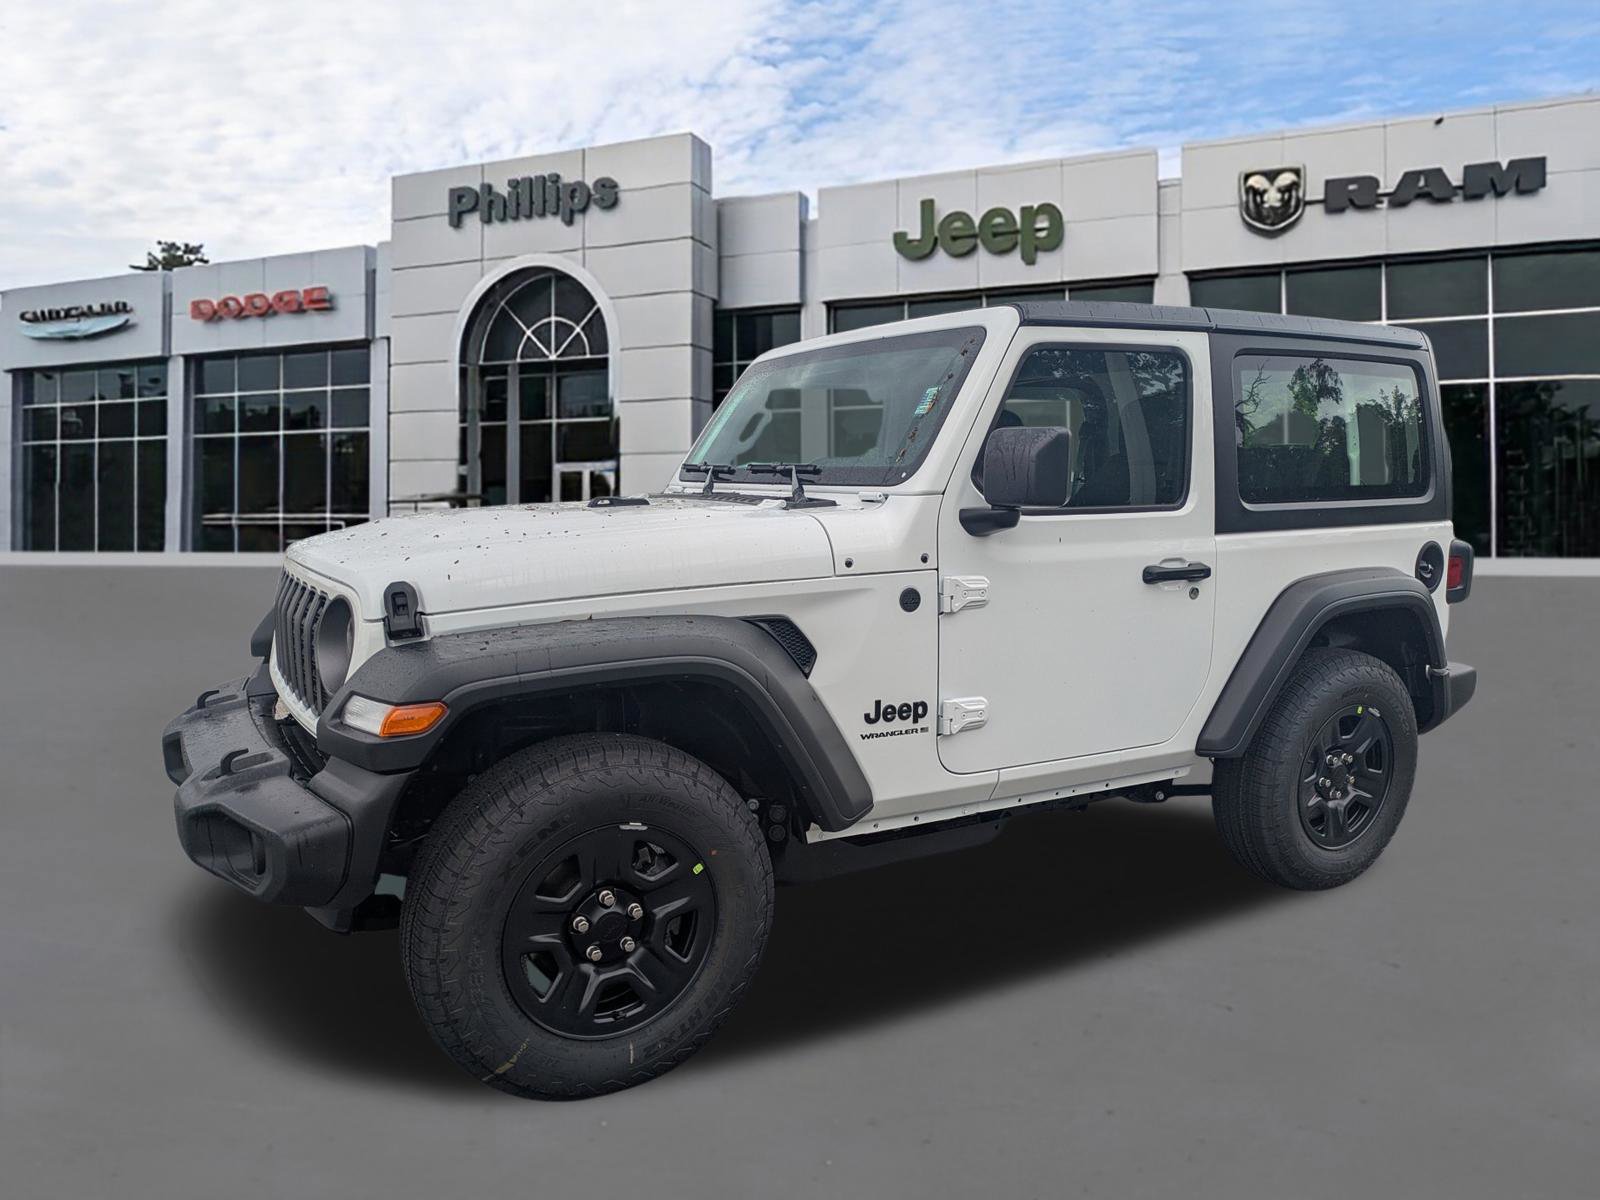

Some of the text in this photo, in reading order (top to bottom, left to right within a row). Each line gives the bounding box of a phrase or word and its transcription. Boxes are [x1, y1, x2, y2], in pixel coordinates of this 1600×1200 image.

[448, 172, 619, 228] Phillips
[1325, 156, 1547, 214] RAM
[893, 198, 1064, 266] Jeep
[190, 286, 334, 322] DODGE
[860, 728, 919, 740] WRANGLER
[863, 699, 928, 725] Jeep
